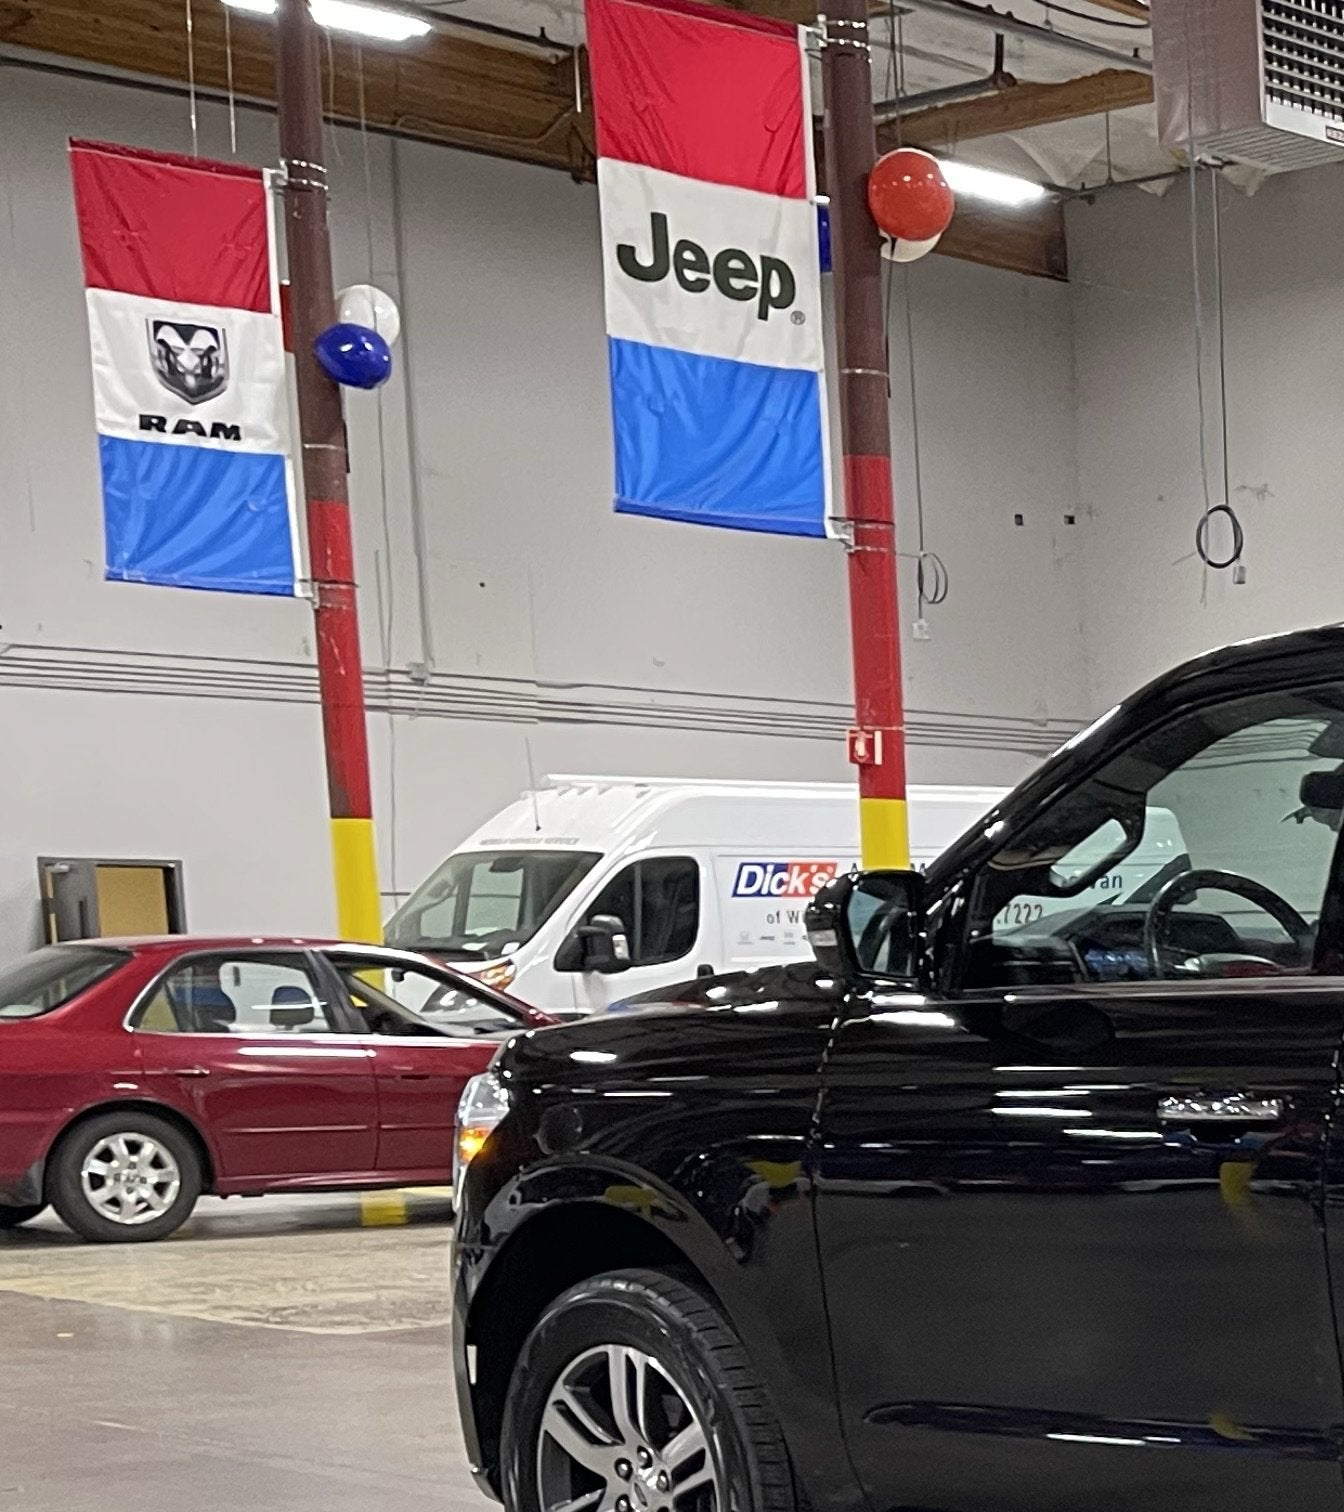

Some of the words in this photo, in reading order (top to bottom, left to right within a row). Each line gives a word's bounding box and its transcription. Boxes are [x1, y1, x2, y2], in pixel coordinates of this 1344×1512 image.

[616, 211, 796, 321] Jeep
[139, 413, 242, 441] RAM
[736, 863, 831, 895] Dick's
[766, 910, 781, 925] of
